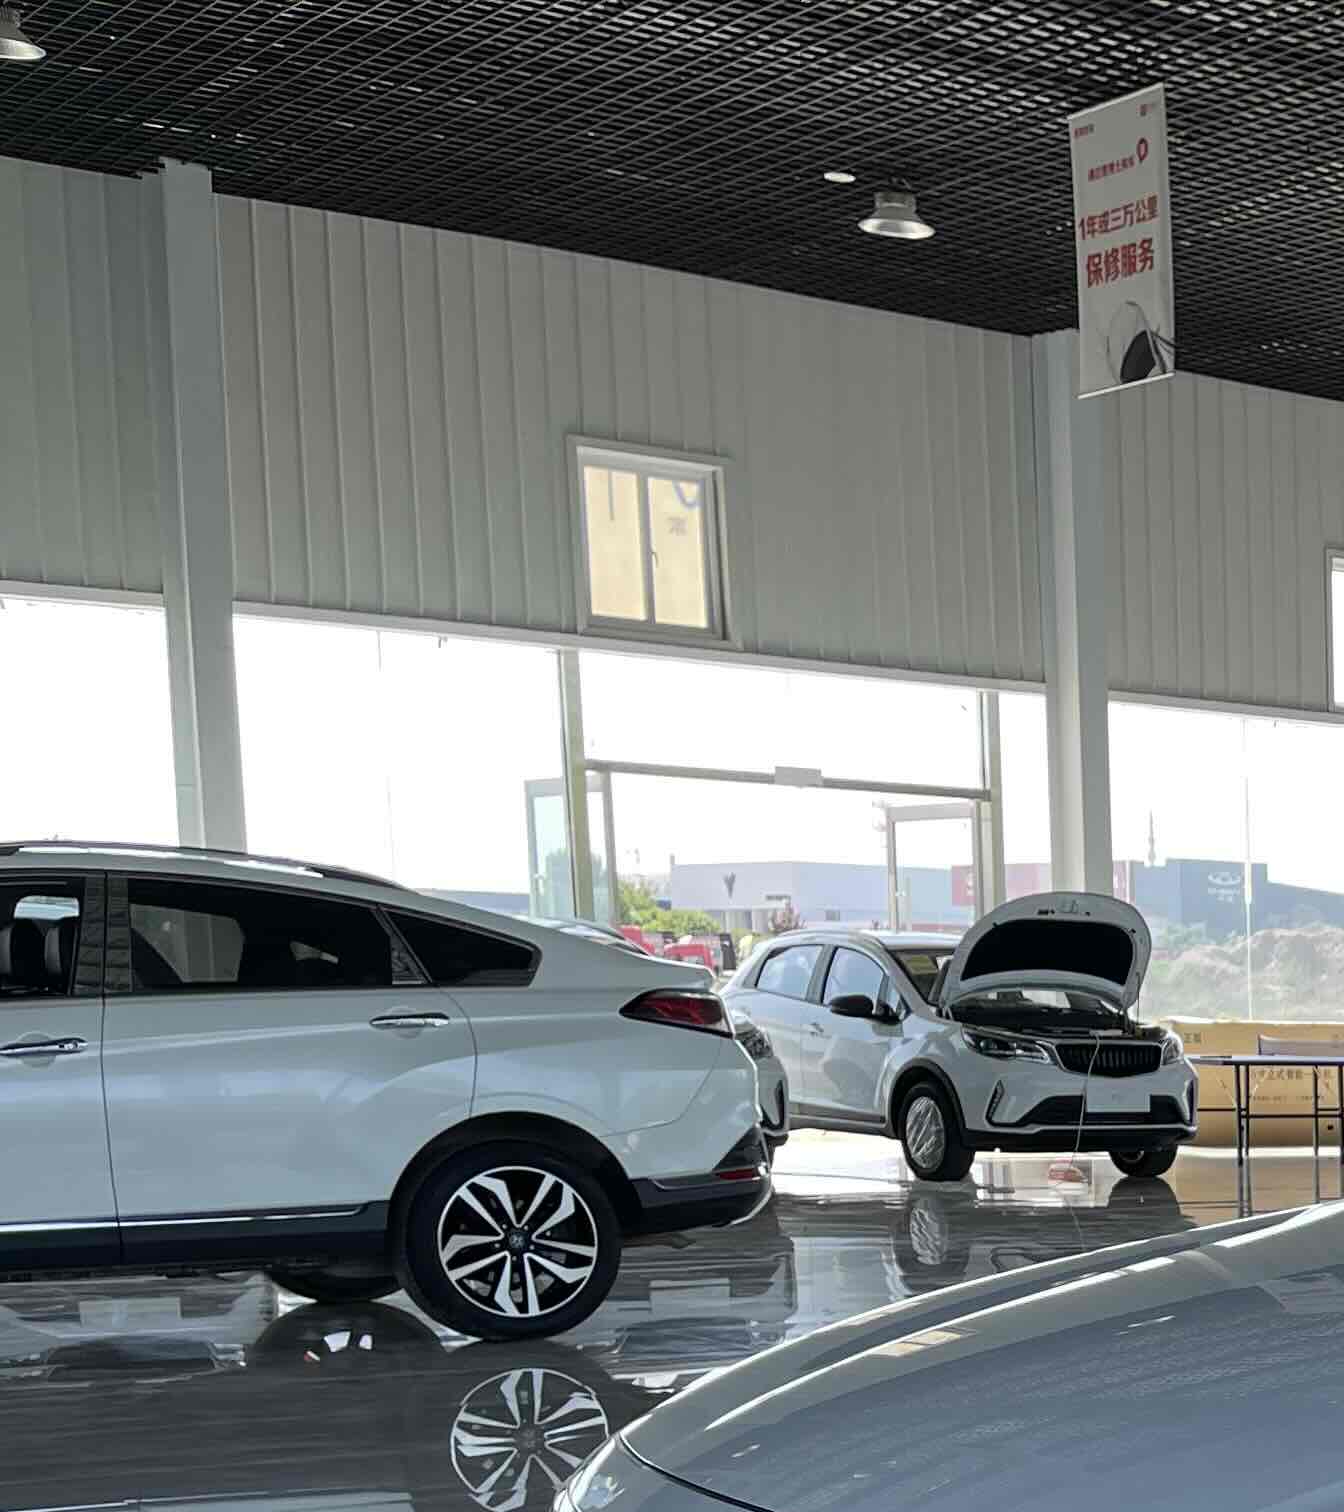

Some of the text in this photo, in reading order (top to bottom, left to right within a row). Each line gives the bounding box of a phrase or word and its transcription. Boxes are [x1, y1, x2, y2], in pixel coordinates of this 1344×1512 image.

[1079, 196, 1158, 240] 1年或三万公里
[1086, 238, 1154, 288] 保修服务
